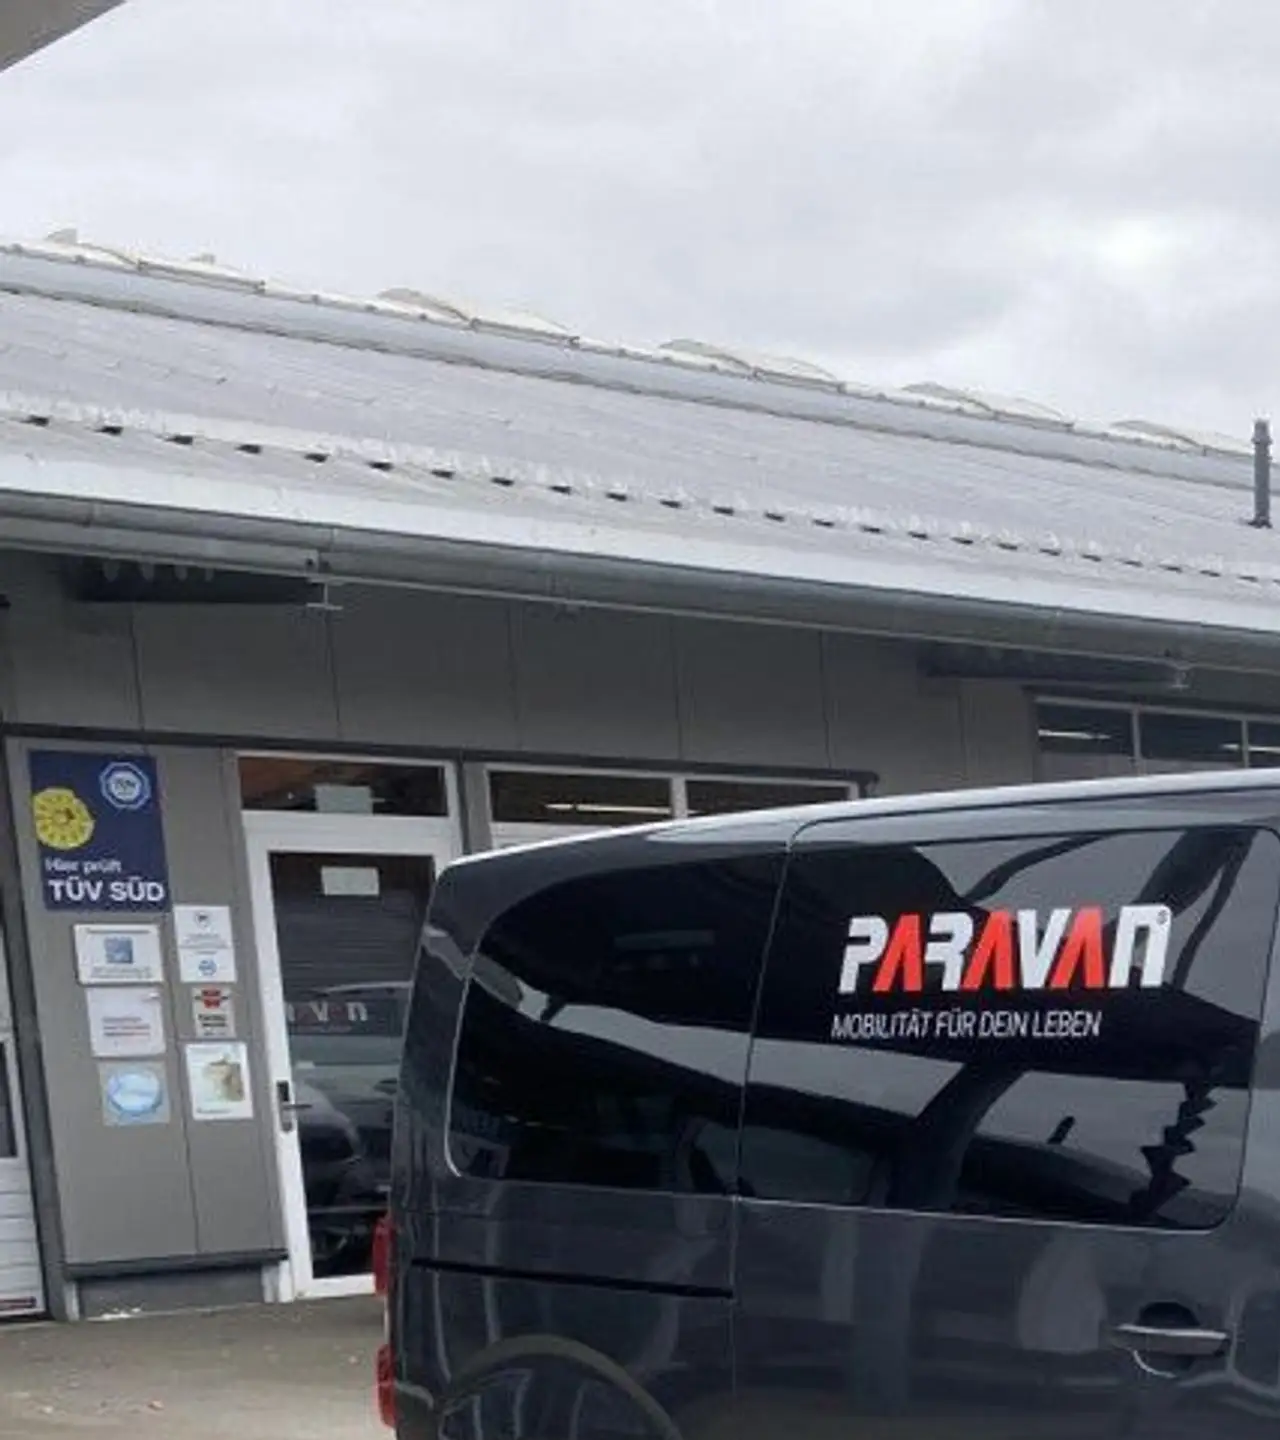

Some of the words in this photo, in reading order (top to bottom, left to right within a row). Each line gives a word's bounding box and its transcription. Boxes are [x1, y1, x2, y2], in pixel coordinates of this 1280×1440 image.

[48, 875, 103, 901] TÜV
[109, 875, 165, 901] SÜD
[838, 904, 1173, 994] PARAVAN
[830, 1007, 934, 1040] MOBILITÄT
[934, 1006, 977, 1038] FÜR
[979, 1009, 1029, 1038] DEIN
[1031, 1009, 1103, 1038] LEBEN
